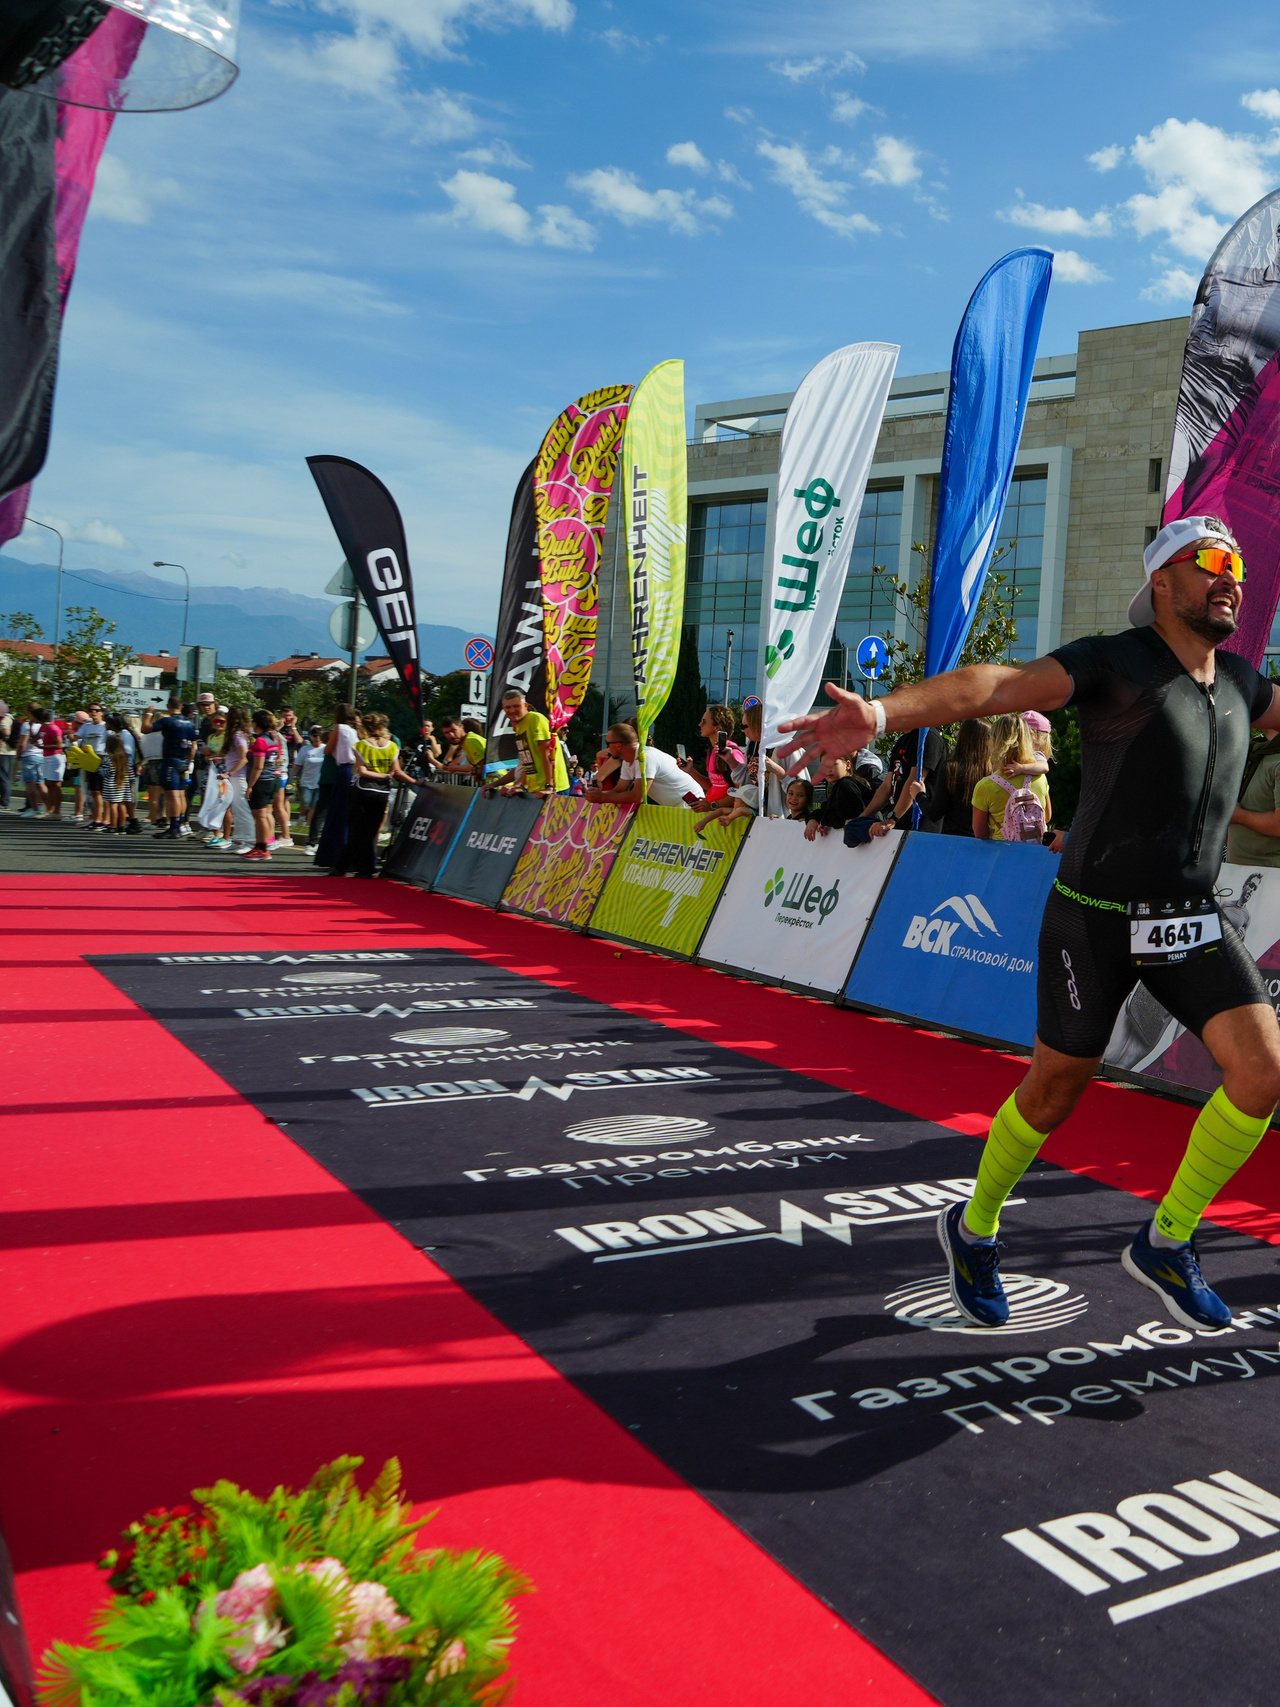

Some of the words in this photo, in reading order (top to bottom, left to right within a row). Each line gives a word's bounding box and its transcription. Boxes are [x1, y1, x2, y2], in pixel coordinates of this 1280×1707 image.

[539, 530, 586, 561] Dubl
[774, 477, 841, 612] Шеф
[540, 553, 590, 596] Bubl
[651, 590, 674, 699] VITAMIN
[409, 816, 450, 845] GEL4U
[628, 837, 724, 874] FAHRENHEIT
[622, 862, 663, 890] VITAMIN
[781, 872, 840, 926] Шеф
[774, 912, 815, 929] Перекрёсток
[902, 915, 960, 956] ВСК
[1148, 921, 1202, 947] 4647
[156, 955, 264, 963] IRON
[310, 952, 411, 961] STAR
[950, 945, 1009, 968] СТРАХОВОЙ
[1007, 957, 1034, 973] ДОМ
[200, 980, 482, 995] Газпромбанк
[258, 986, 453, 998] Премиум
[1062, 949, 1081, 1011] orca
[233, 1004, 362, 1018] IRON
[411, 998, 534, 1009] STAR
[300, 1040, 635, 1065] Газпромбанк
[371, 1048, 604, 1069] Премиум
[350, 1078, 511, 1103] IRON
[575, 1066, 716, 1086] STAR
[462, 1133, 876, 1182] Газпромбанк
[559, 1151, 848, 1190] Премиум
[553, 1206, 768, 1253] IRON
